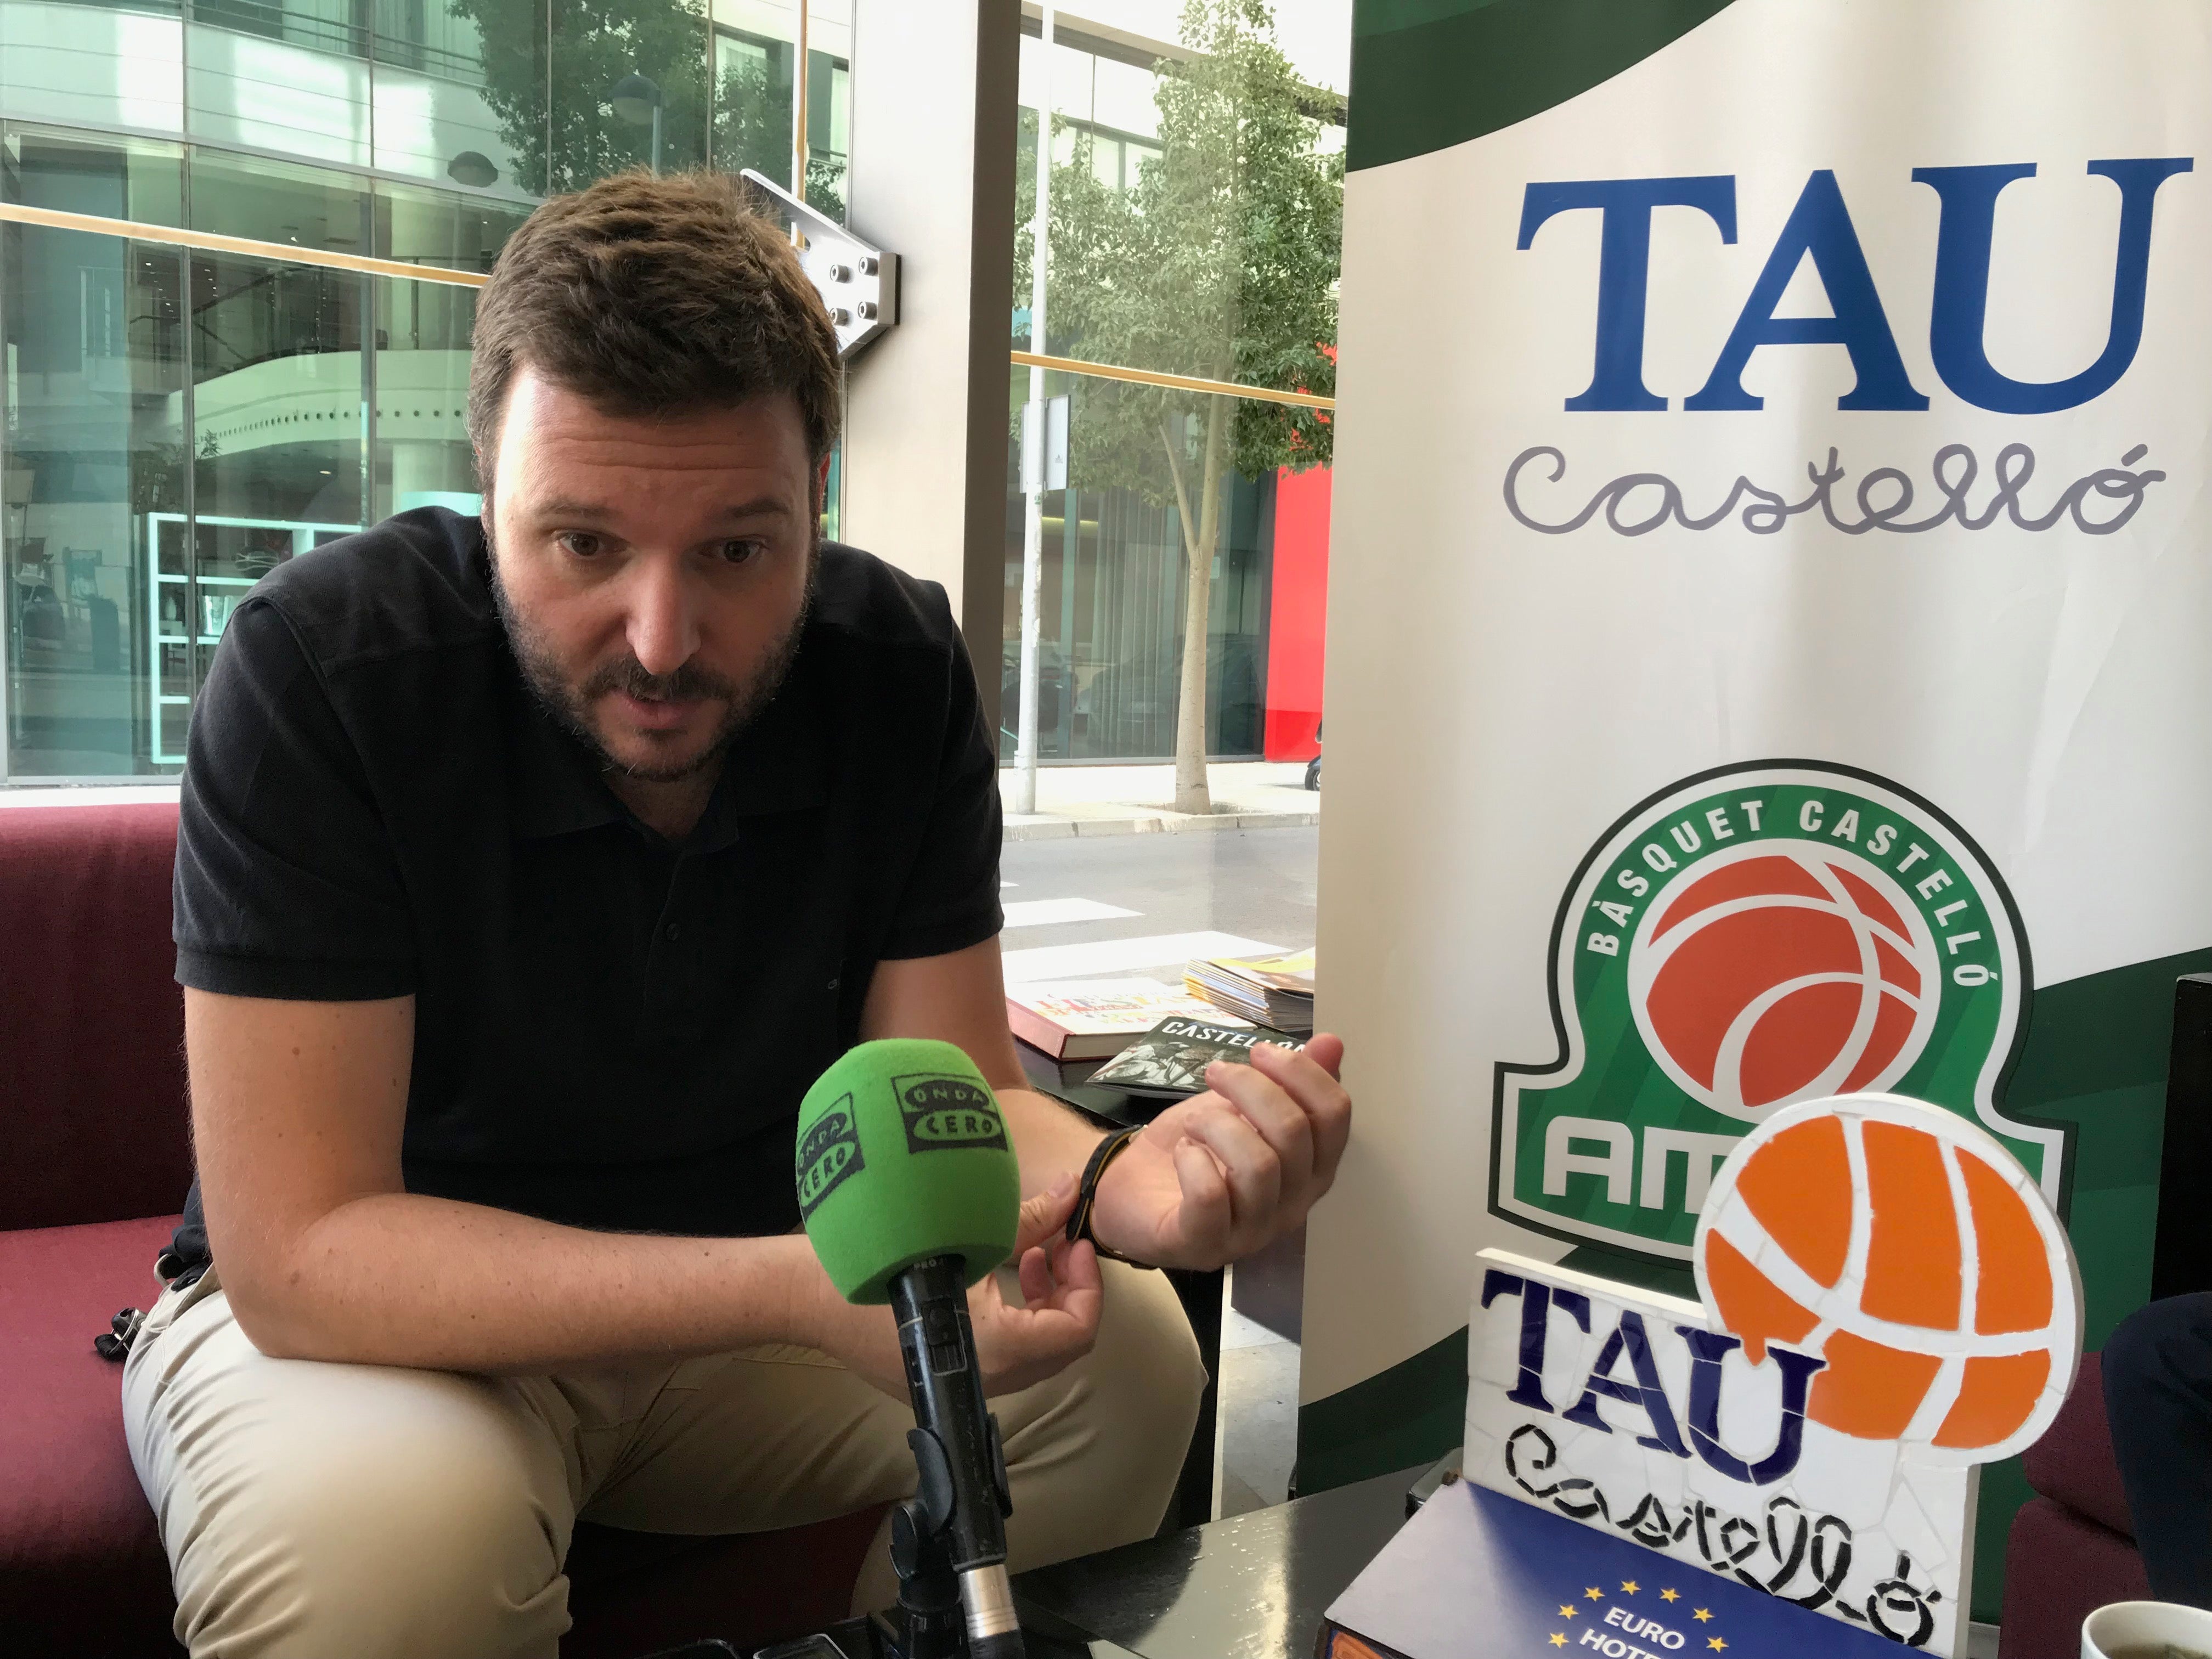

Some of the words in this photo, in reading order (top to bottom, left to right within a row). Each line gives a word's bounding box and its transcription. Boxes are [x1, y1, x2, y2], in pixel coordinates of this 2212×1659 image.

[1516, 157, 2194, 414] TAU
[1504, 443, 2166, 535] Castelló
[1587, 800, 1763, 956] BÀSQUET
[1799, 800, 1997, 986] CASTELLÓ
[914, 1087, 983, 1103] ONDA
[926, 1115, 992, 1135] CERO
[798, 1119, 840, 1169] ONDA
[804, 1147, 845, 1198] CERO
[1481, 1270, 1828, 1485] TAU
[1505, 1424, 1942, 1646] Castelló
[1604, 1607, 1685, 1649] EURO
